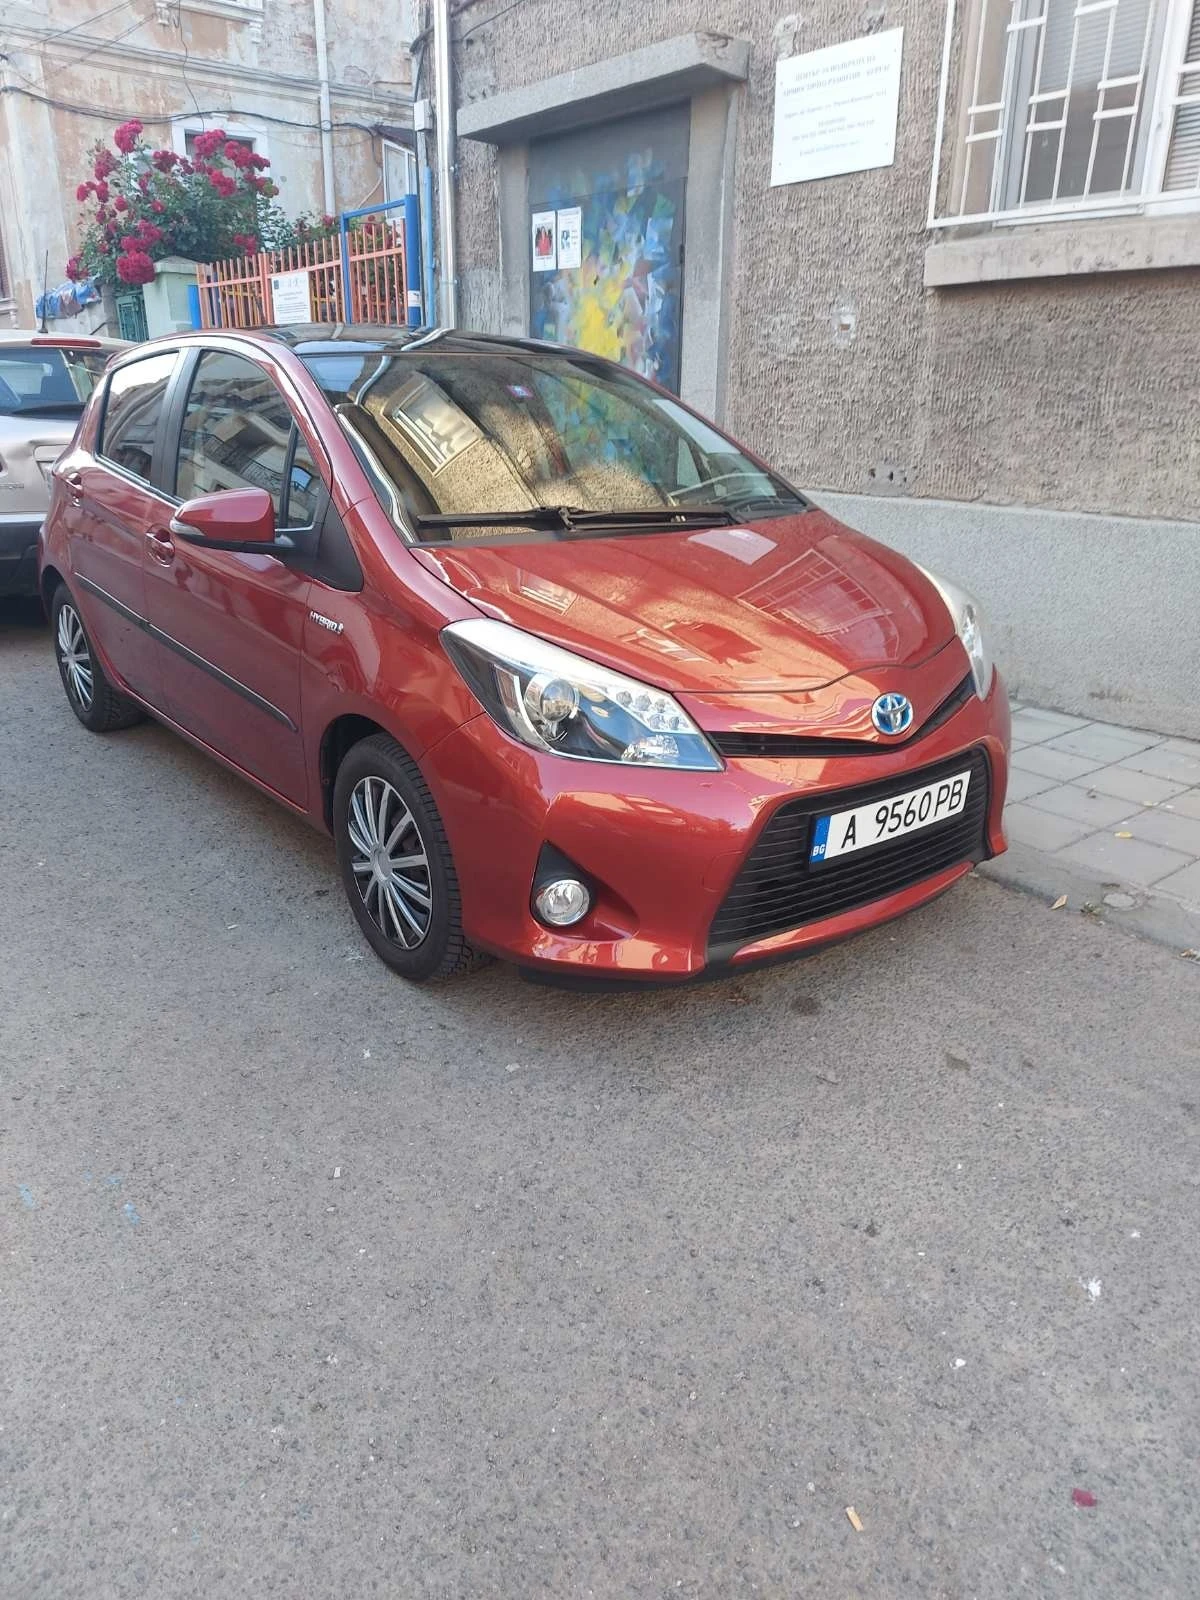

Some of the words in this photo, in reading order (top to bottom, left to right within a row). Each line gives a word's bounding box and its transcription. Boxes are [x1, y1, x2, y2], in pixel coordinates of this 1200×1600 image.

[310, 611, 338, 632] HYBRID
[841, 814, 856, 848] A
[812, 844, 825, 856] BG
